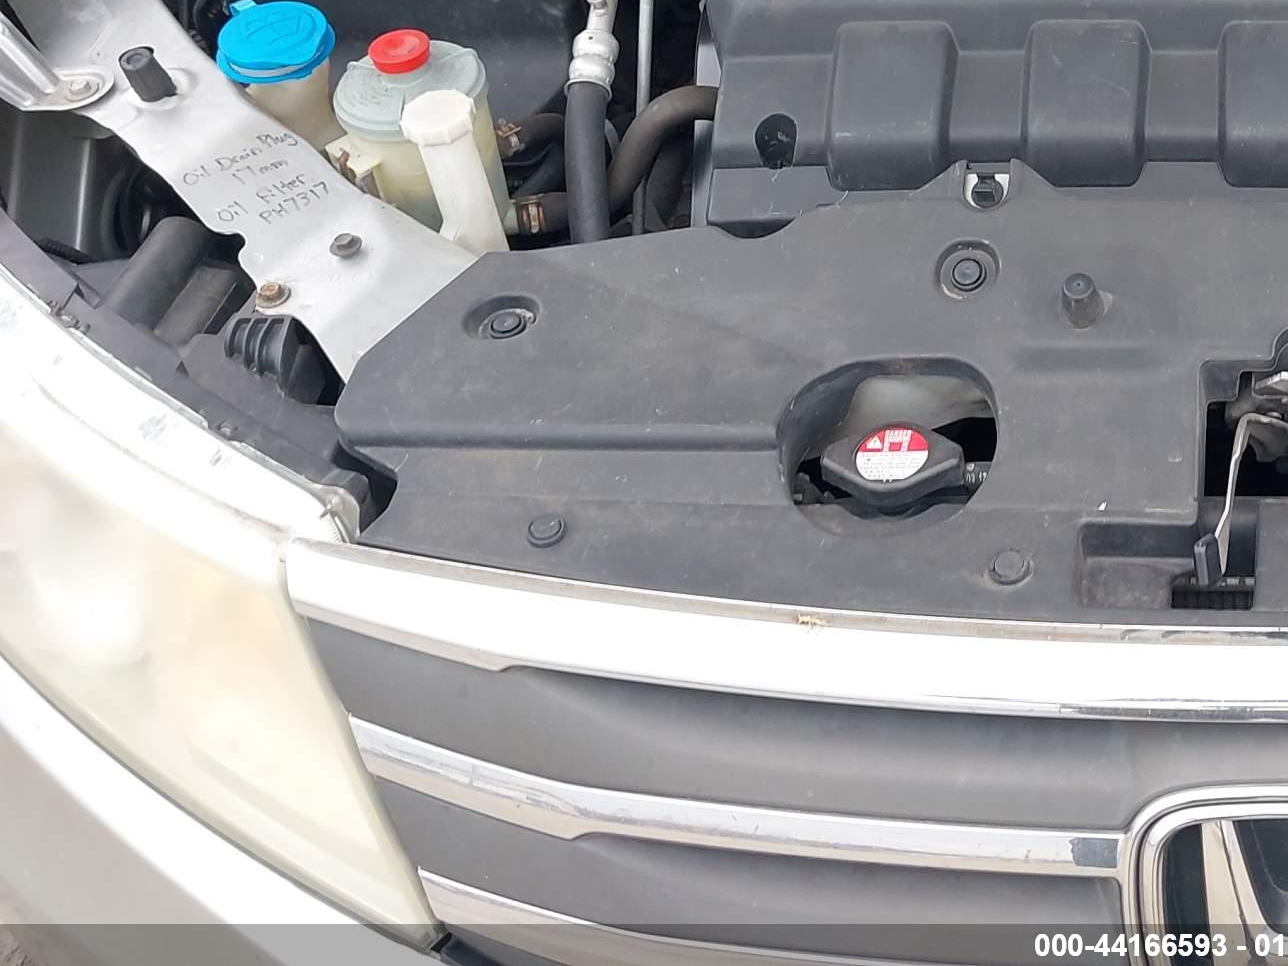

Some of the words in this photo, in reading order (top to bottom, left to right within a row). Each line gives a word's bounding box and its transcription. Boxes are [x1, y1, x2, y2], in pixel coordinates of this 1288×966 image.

[183, 165, 210, 186] Oil
[215, 146, 262, 172] Drain
[256, 133, 299, 149] Plug
[217, 201, 249, 223] Oil
[256, 173, 305, 205] Filter
[259, 181, 329, 225] PH7317
